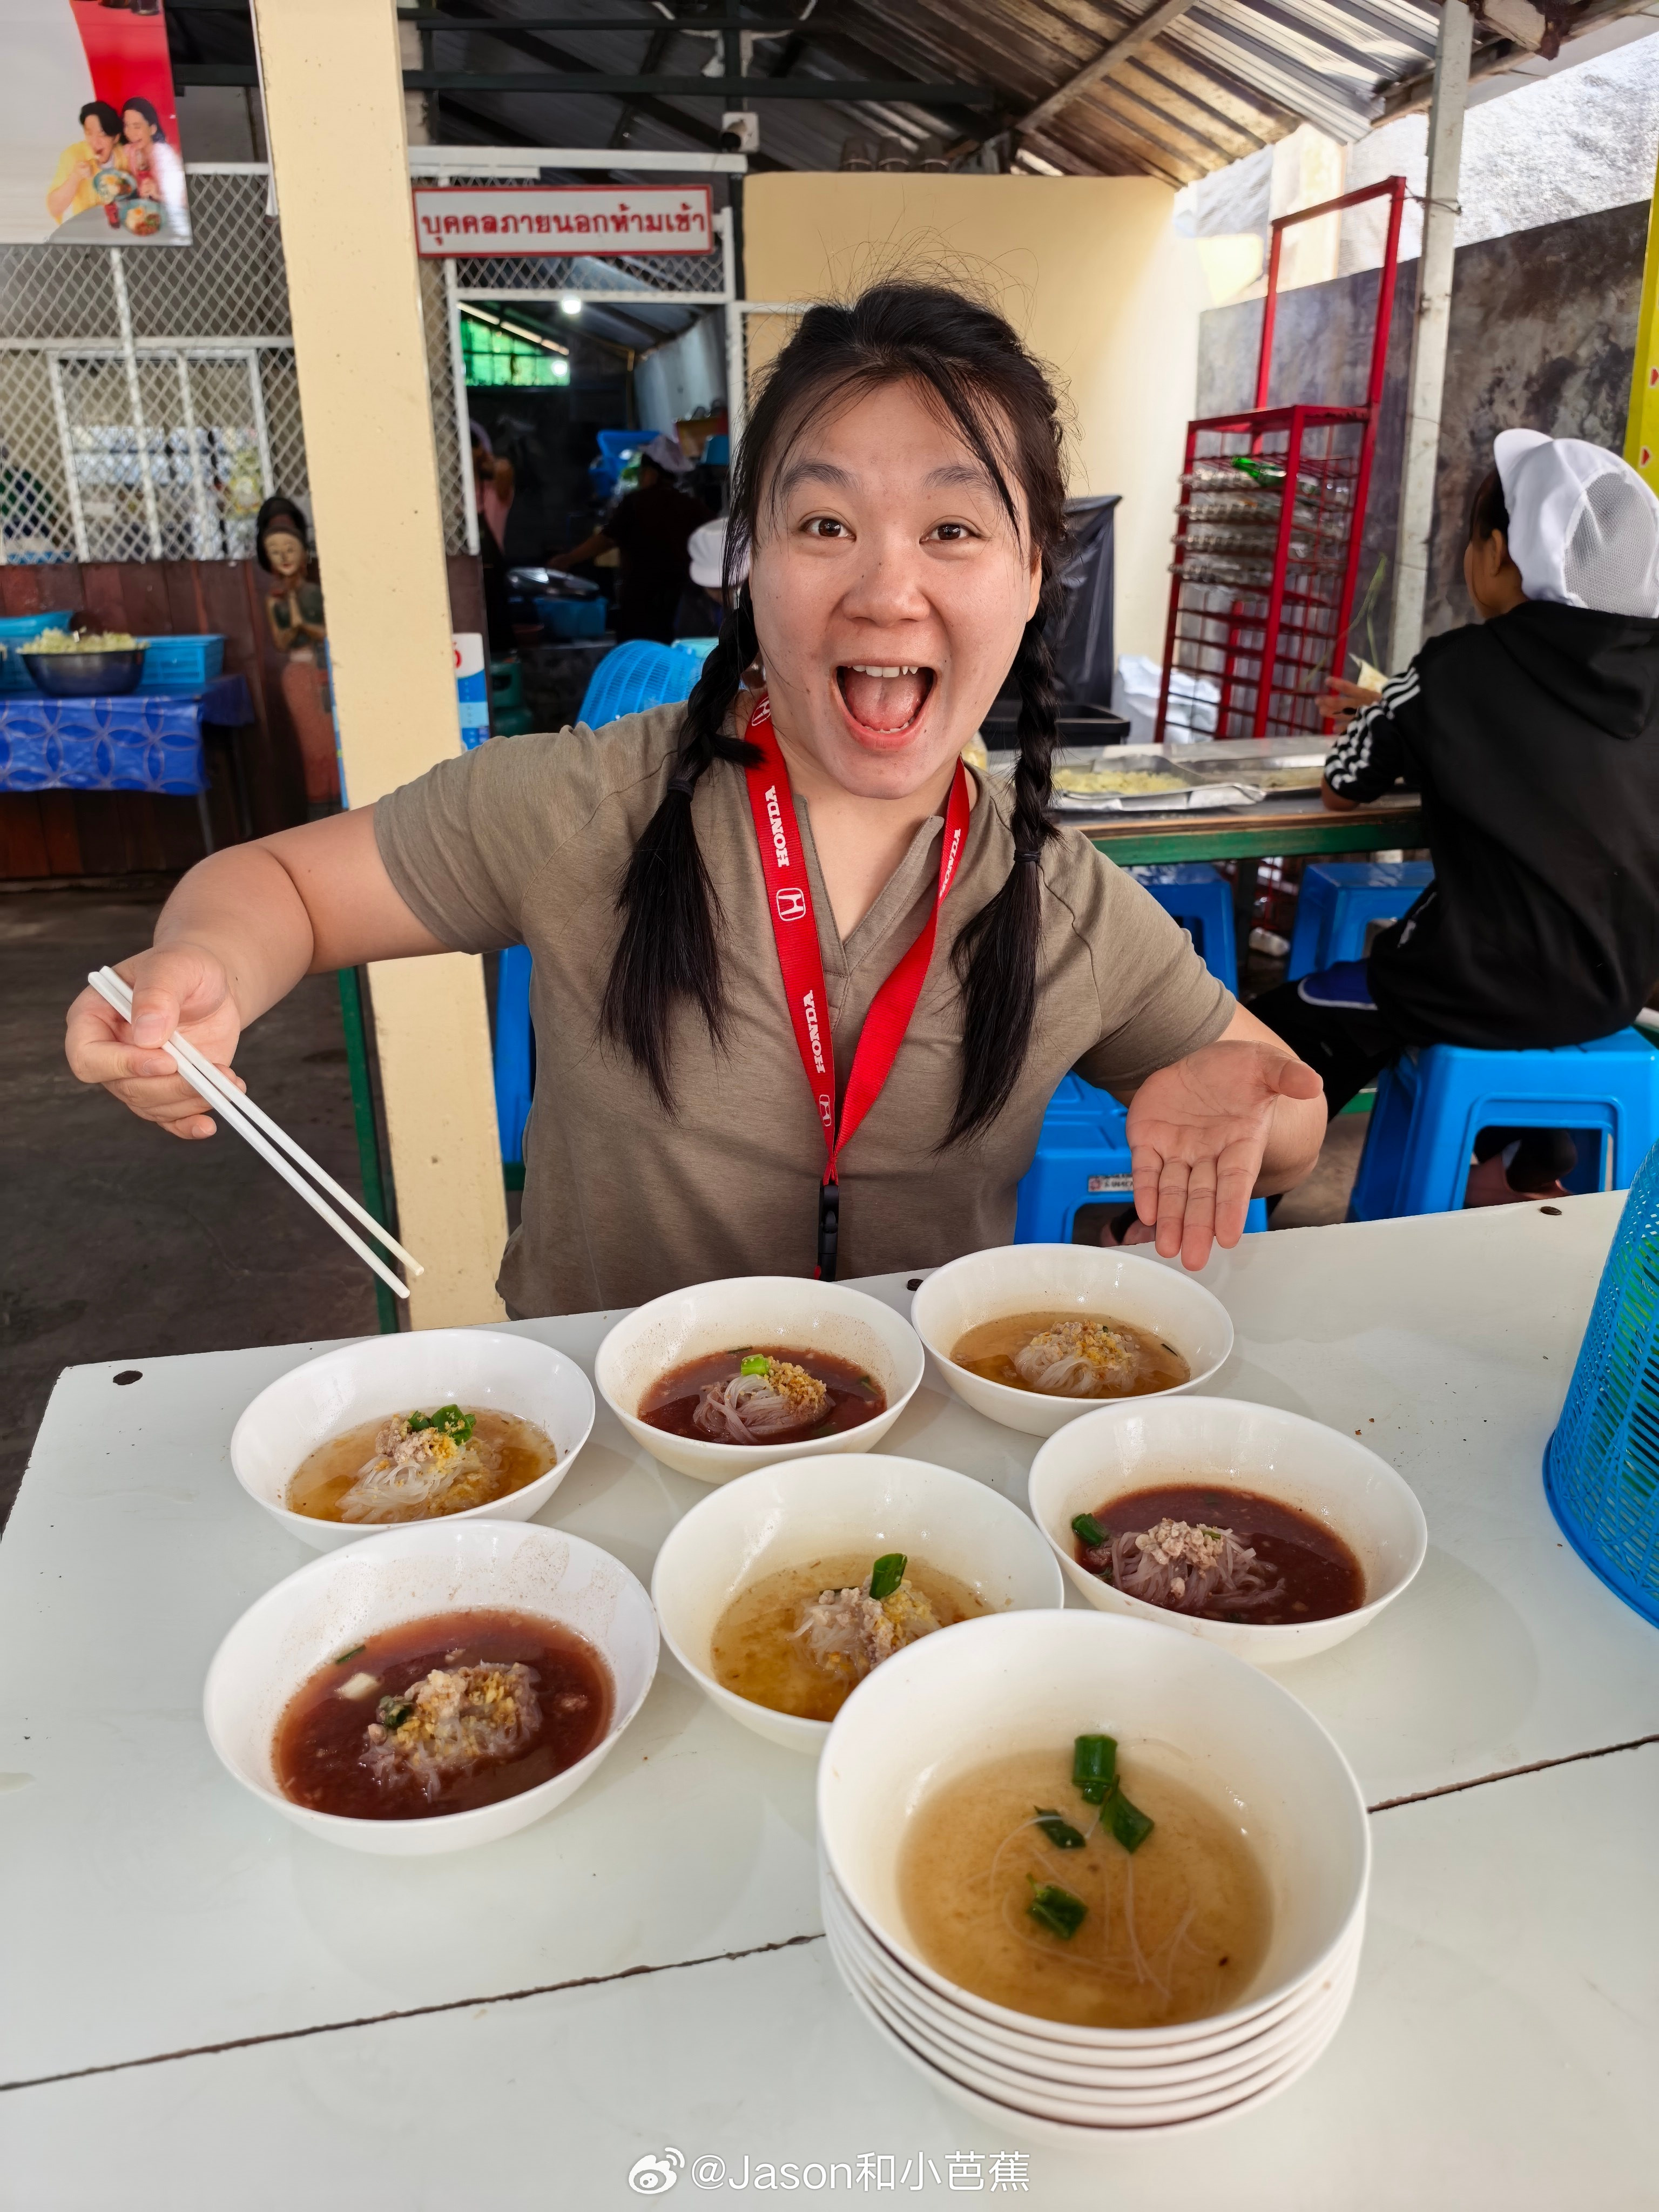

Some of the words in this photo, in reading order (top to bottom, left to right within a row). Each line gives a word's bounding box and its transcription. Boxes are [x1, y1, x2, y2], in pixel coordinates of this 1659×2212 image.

[422, 202, 705, 246] บุคคลภายนอกห้ามเข้า
[764, 785, 790, 868] HONDA
[803, 989, 826, 1074] HONDA
